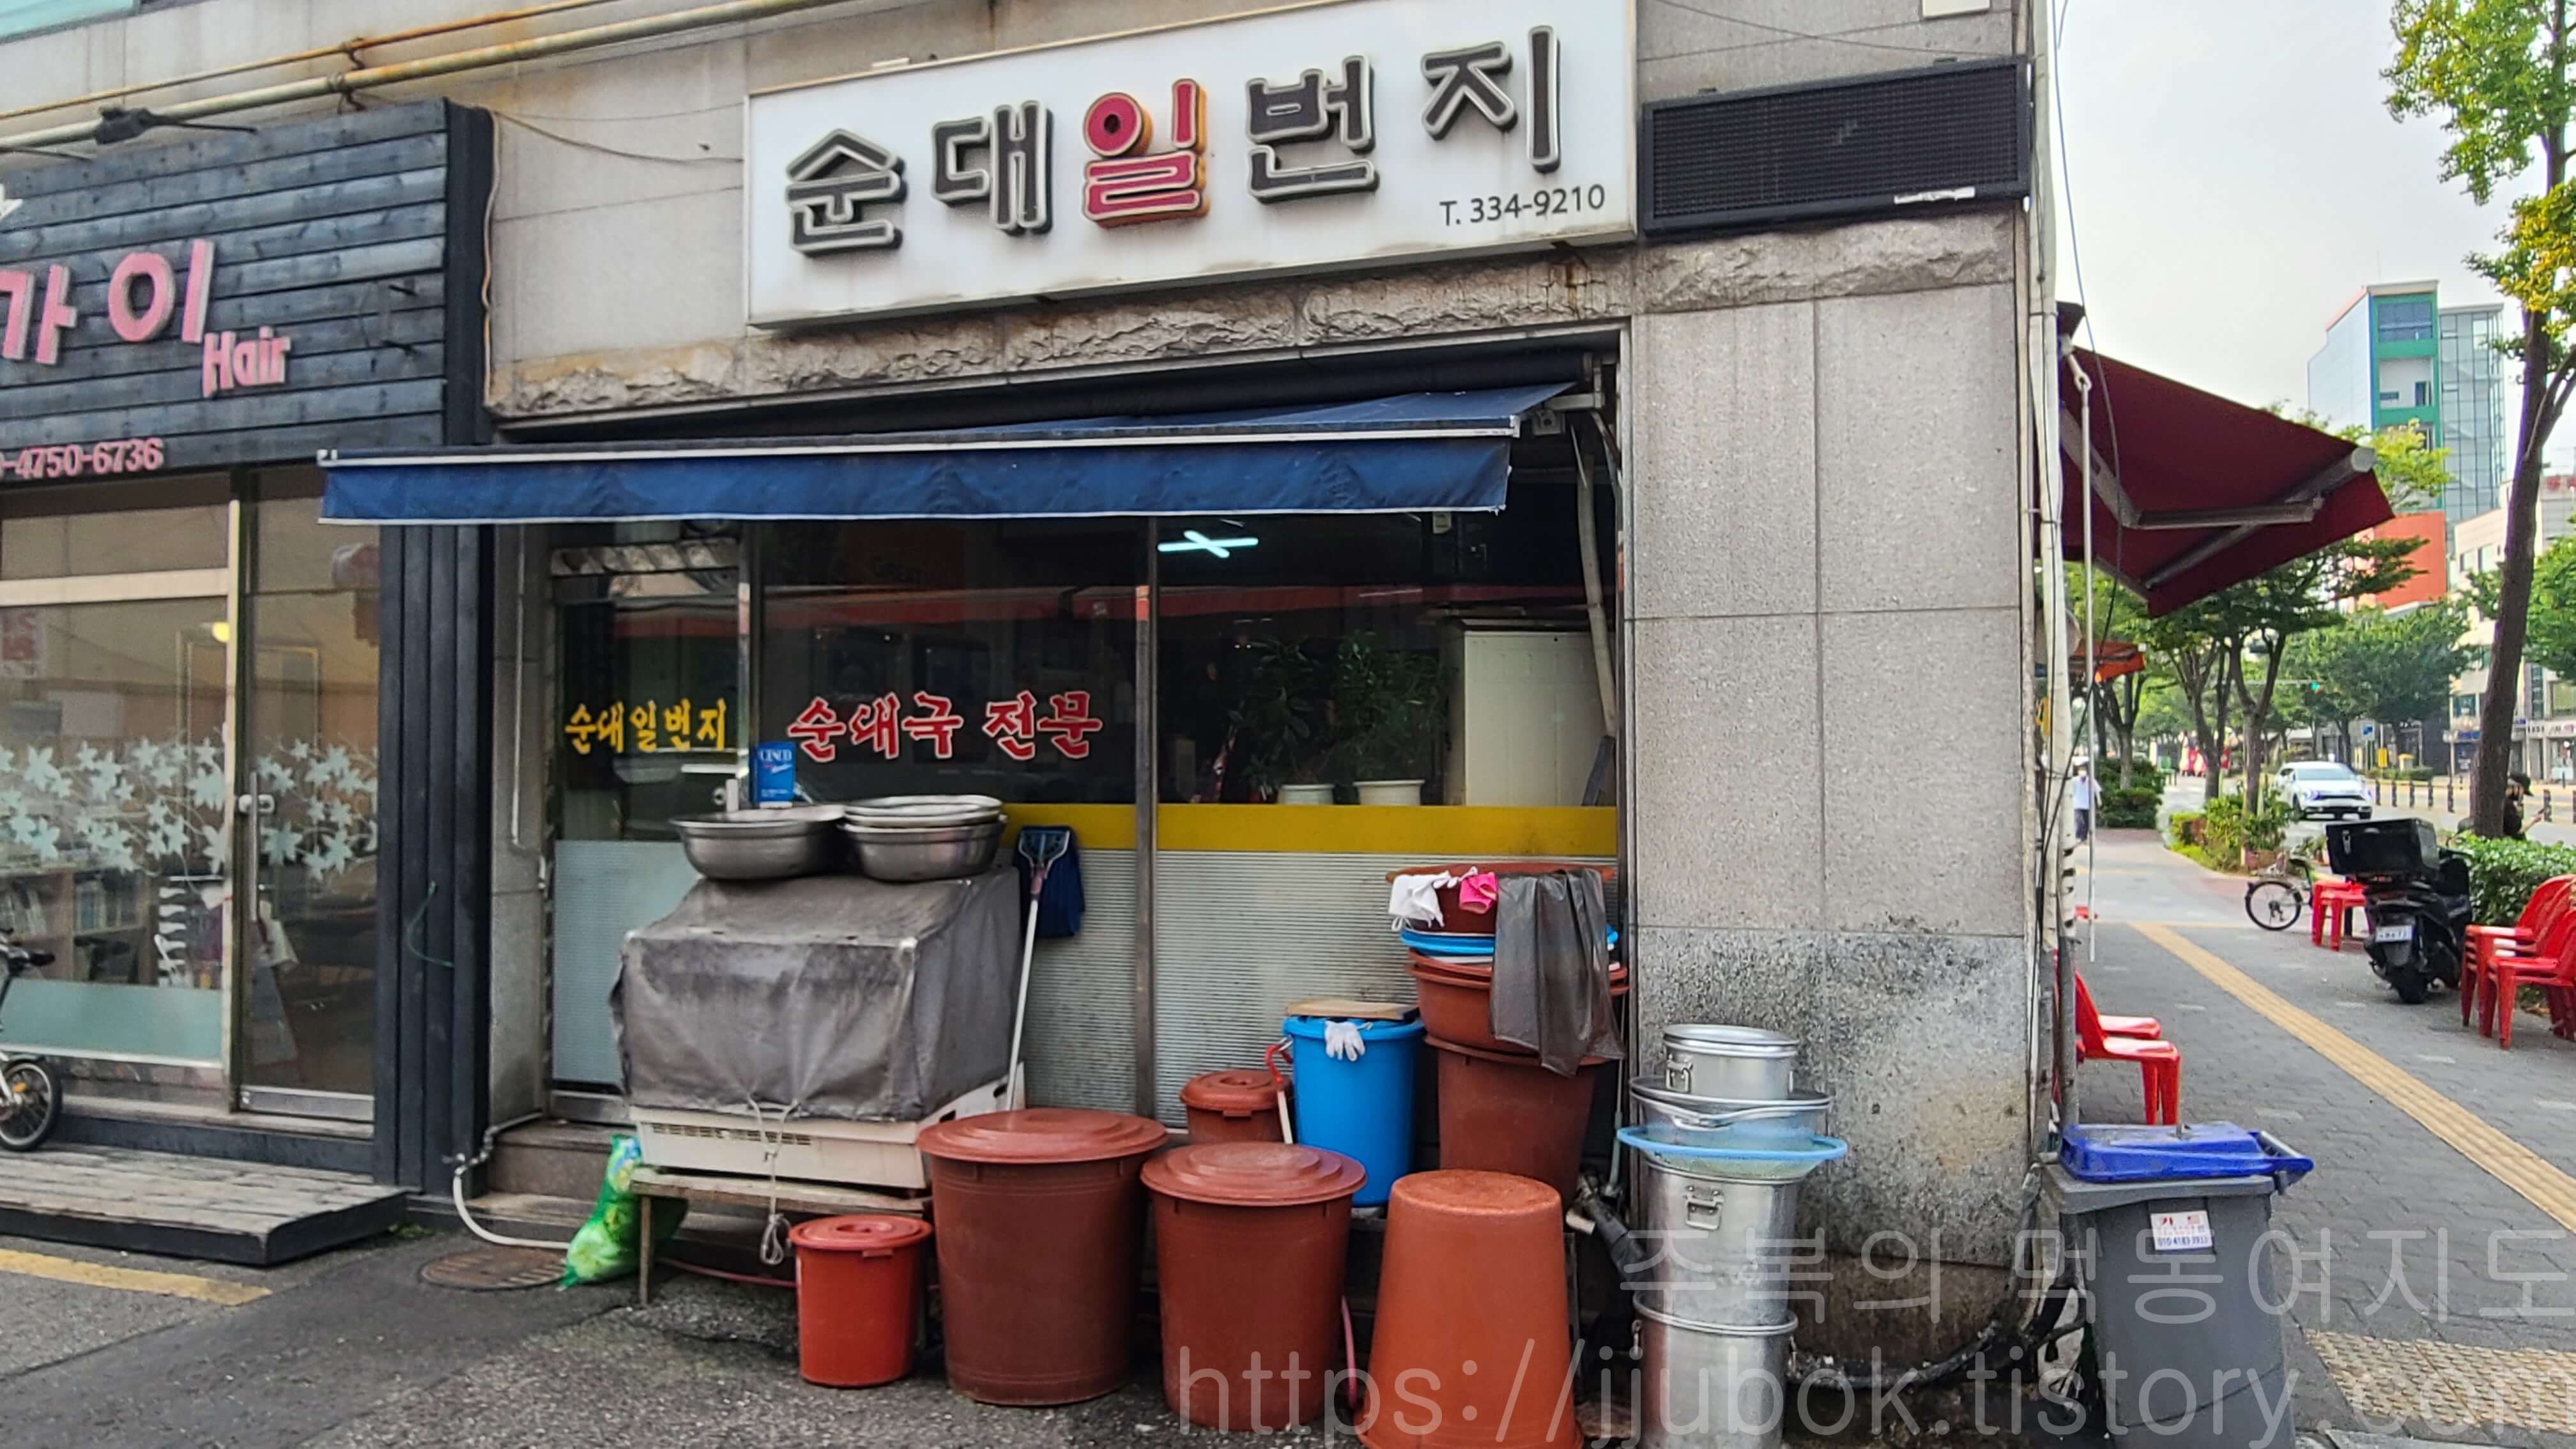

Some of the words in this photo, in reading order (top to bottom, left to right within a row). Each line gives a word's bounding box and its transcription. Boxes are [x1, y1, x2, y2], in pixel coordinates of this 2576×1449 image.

[785, 26, 1561, 257] 순대일번지
[1469, 184, 1605, 224] 334-9210
[202, 326, 291, 397] Hair
[0, 437, 164, 479] -4750-6736
[565, 698, 727, 755] 순대일번지
[788, 691, 963, 762] 순대국
[983, 690, 1103, 760] 전문
